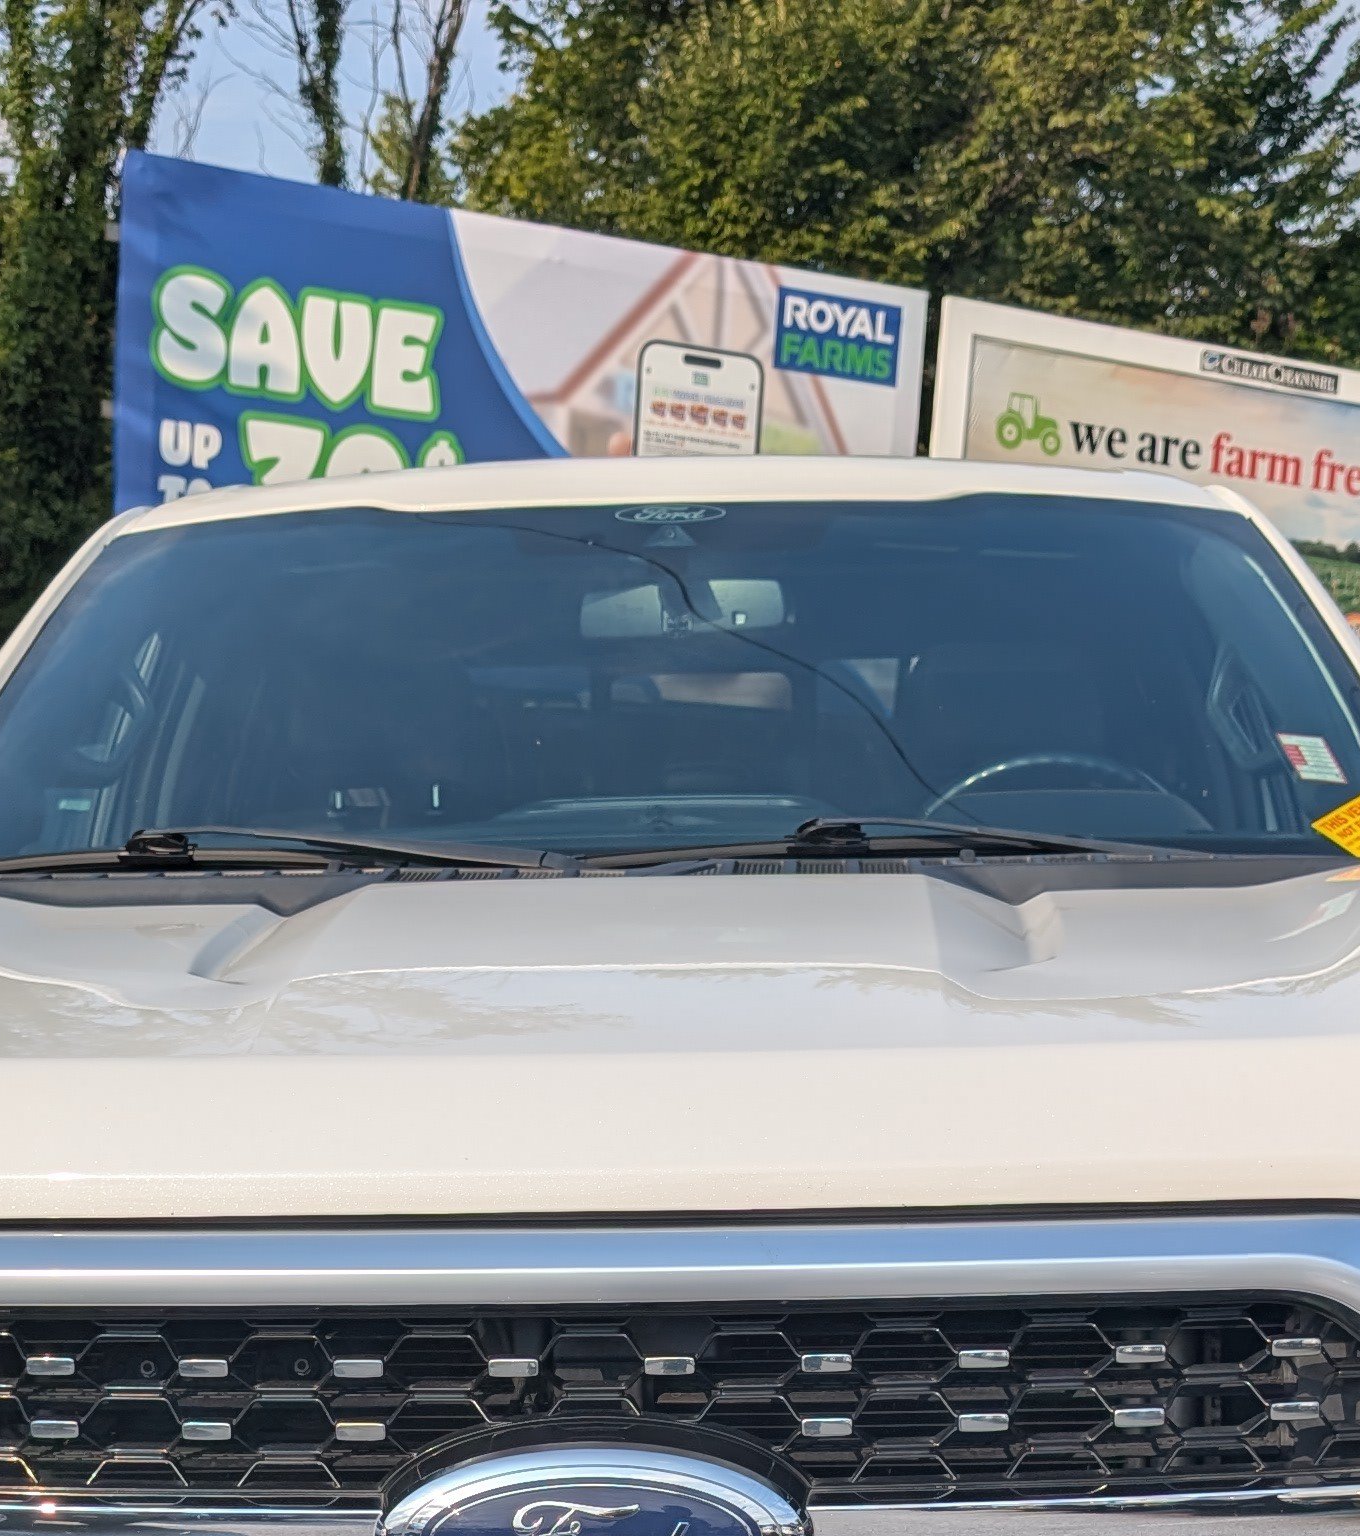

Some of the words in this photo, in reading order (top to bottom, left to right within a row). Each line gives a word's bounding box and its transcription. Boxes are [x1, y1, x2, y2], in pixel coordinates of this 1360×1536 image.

[151, 265, 443, 421] SAVE
[782, 295, 895, 345] ROYAL
[780, 332, 893, 379] FARMS
[158, 418, 223, 469] UP
[1070, 420, 1127, 459] we
[1137, 431, 1202, 471] are
[1210, 432, 1302, 487] farm
[633, 505, 707, 522] Ford
